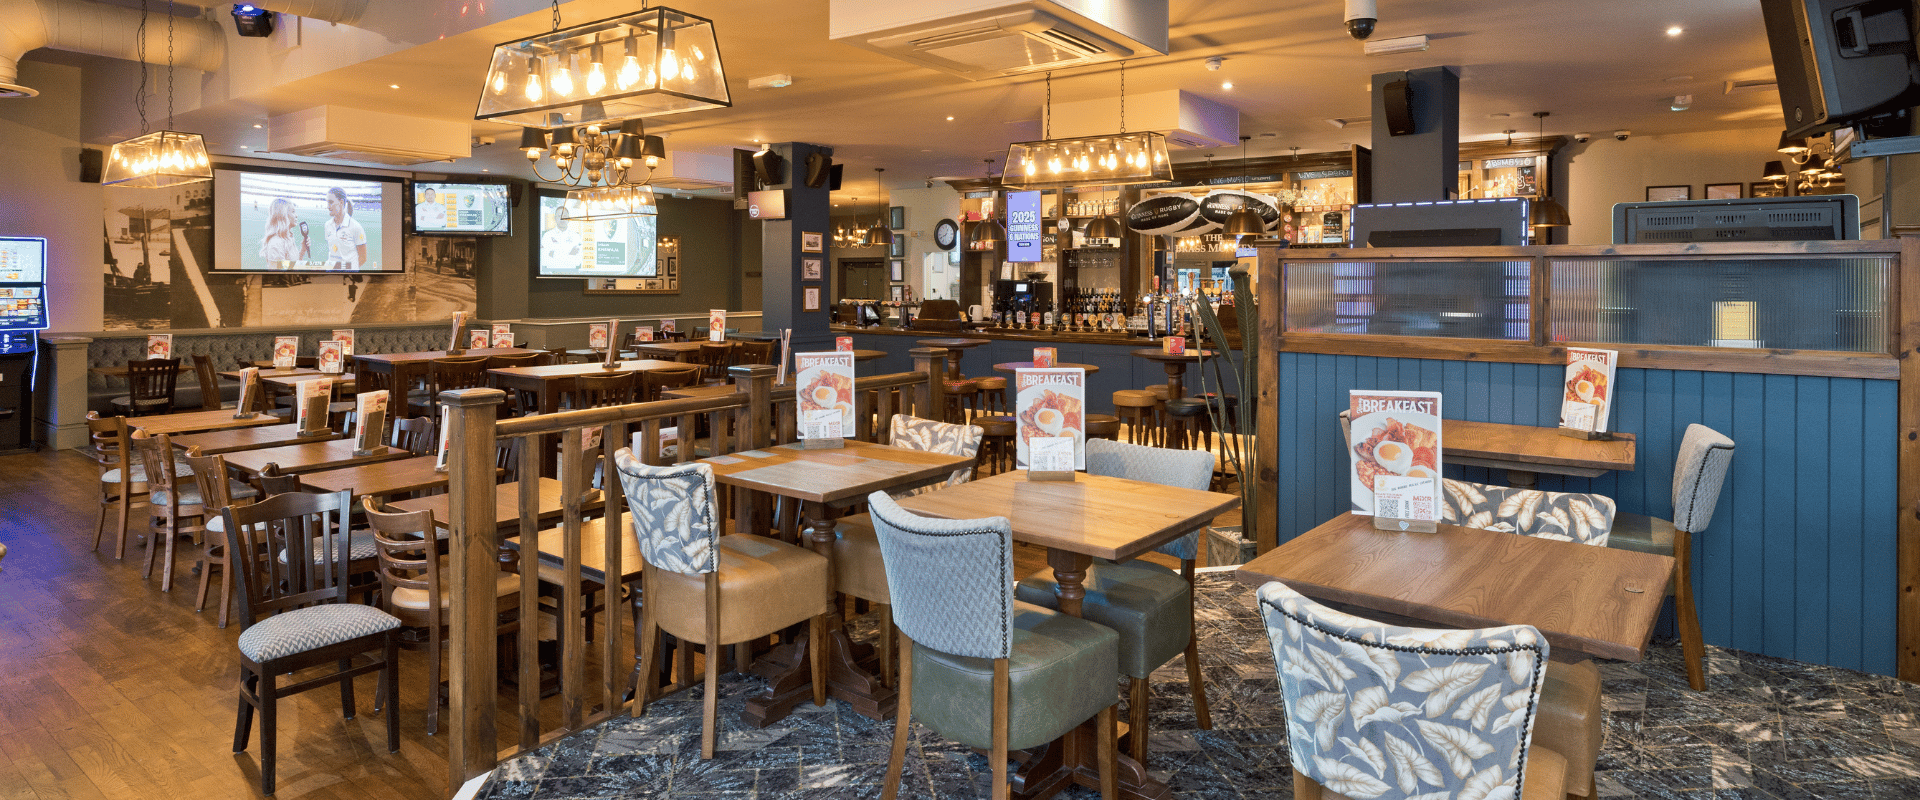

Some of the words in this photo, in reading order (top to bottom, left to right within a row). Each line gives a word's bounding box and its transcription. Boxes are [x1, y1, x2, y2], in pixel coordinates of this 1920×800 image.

[1160, 204, 1181, 213] RUGBY
[1012, 211, 1036, 223] 2025
[1009, 223, 1039, 232] GUINNESS
[1014, 232, 1039, 241] NATIONS
[1204, 233, 1223, 242] THE
[1175, 244, 1207, 253] BRASS
[804, 357, 849, 367] BREAKFAST
[1572, 352, 1606, 364] BREAKFAST
[1026, 374, 1078, 386] BREAKFAST
[1362, 399, 1433, 414] BREAKFAST
